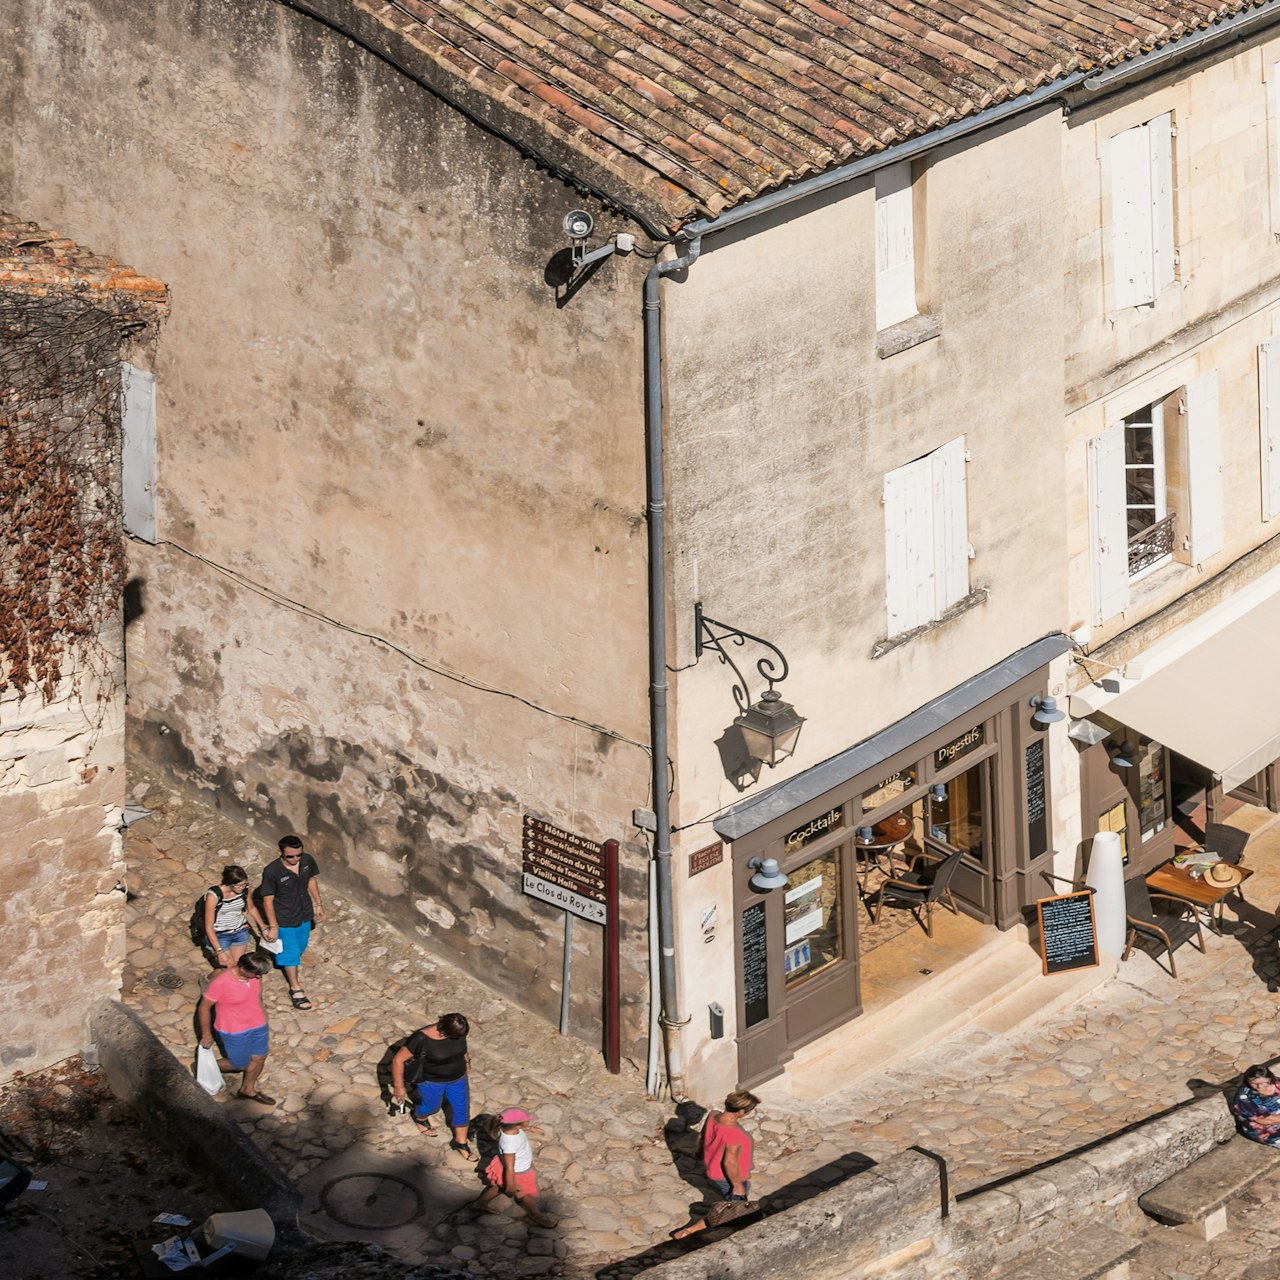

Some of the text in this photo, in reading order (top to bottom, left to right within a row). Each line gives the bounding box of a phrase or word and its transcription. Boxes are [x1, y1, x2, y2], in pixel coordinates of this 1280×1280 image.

[938, 726, 980, 762] Digestifs
[544, 824, 601, 853] Hôtel de ville
[787, 810, 843, 846] Cocktails
[540, 858, 590, 883] Office de Tourisme
[545, 848, 601, 877] Maison du Vin
[532, 866, 578, 890] Vieille Halle
[525, 877, 587, 912] Le Clos du Roy
